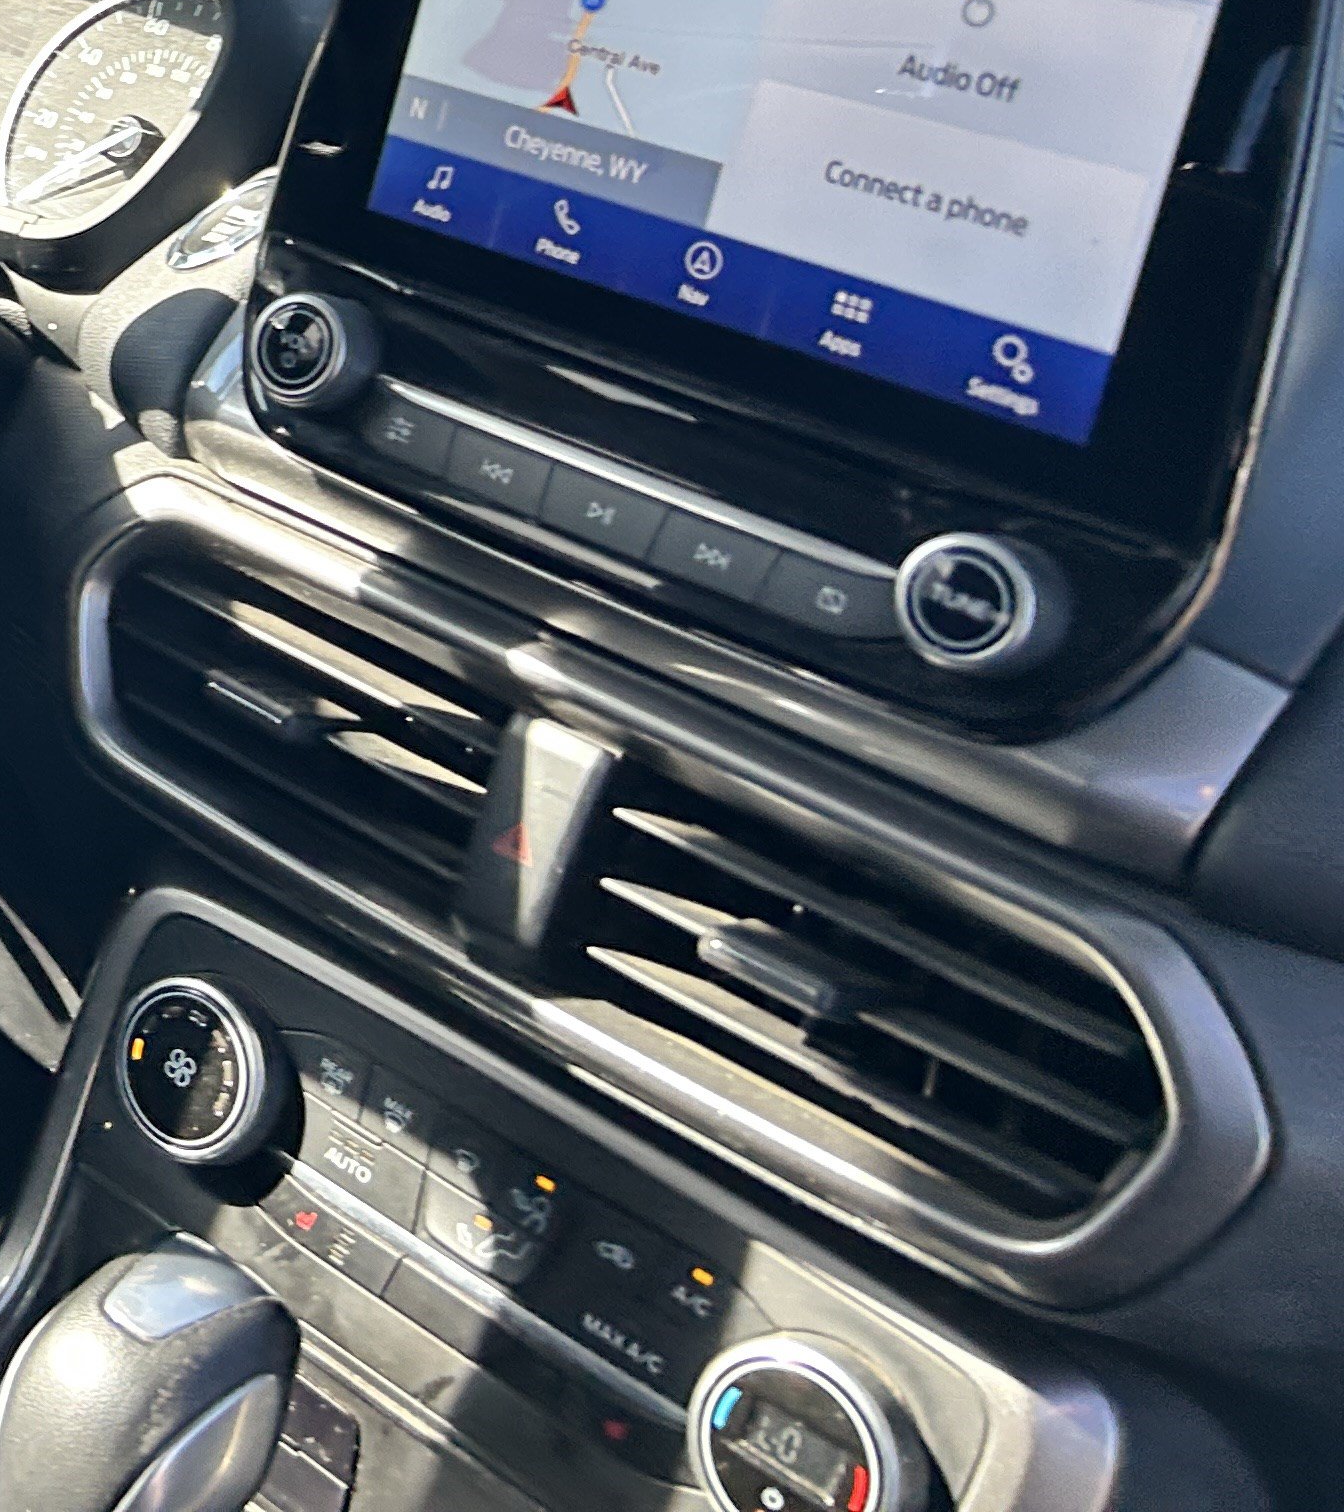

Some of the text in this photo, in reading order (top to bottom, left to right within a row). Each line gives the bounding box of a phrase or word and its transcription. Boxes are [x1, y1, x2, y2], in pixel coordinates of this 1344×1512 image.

[568, 39, 661, 76] Central Ave
[898, 54, 1022, 103] Audio Off
[409, 96, 430, 121] N
[503, 125, 651, 186] Cheyenne, WY
[412, 198, 453, 223] Audio
[824, 159, 1030, 238] Connect a phone
[534, 236, 581, 265] Phone
[676, 283, 710, 306] Nav
[817, 329, 862, 358] Apps
[965, 375, 1040, 417] Settings
[323, 1147, 372, 1184] AUTO
[671, 1285, 712, 1318] A/C
